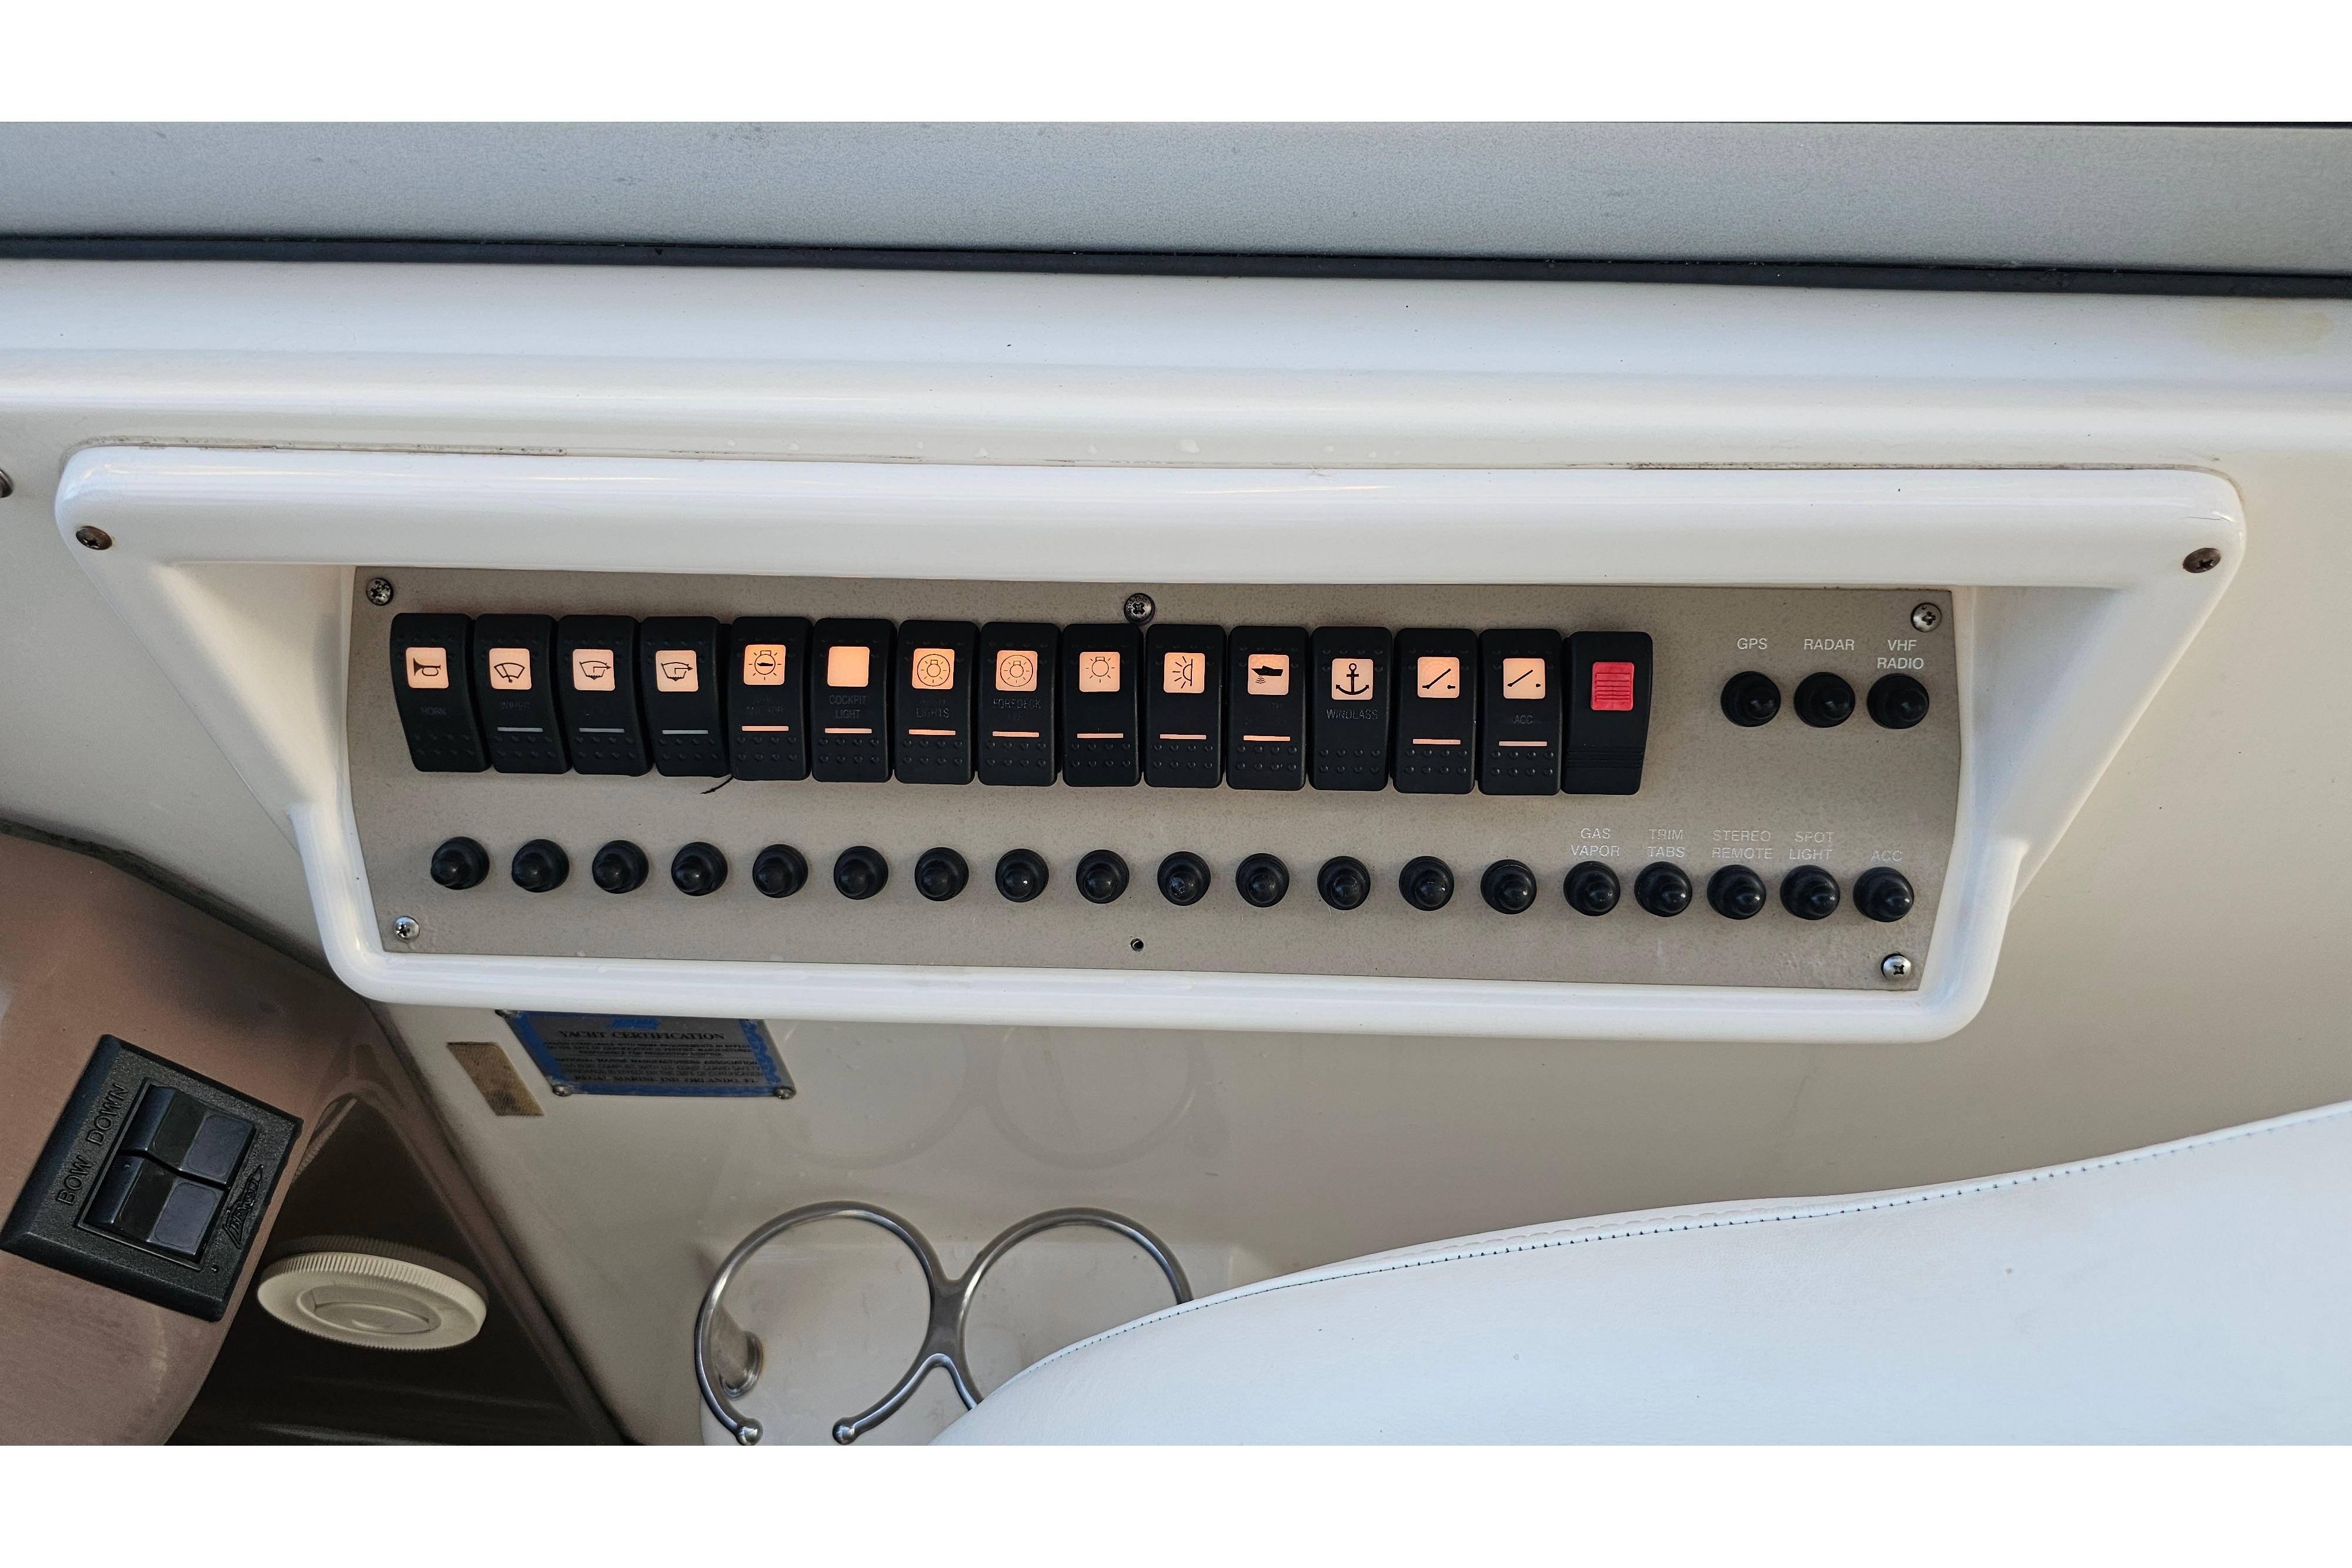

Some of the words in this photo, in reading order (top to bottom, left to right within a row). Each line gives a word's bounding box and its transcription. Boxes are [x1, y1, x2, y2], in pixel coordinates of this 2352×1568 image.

[1736, 637, 1768, 650] GPS
[1803, 638, 1855, 651] RADAR
[1887, 639, 1917, 651] VHF
[1876, 657, 1925, 670] RADIO
[828, 694, 867, 705] COCKPIT
[835, 708, 861, 719] LIGHT
[916, 707, 950, 718] LIGHTS
[1326, 708, 1379, 720] WINDLASS
[1514, 714, 1534, 724] ACC
[1580, 827, 1611, 840] GAS
[1648, 828, 1683, 841] TRIM
[1712, 830, 1771, 842] STEREO
[1794, 831, 1835, 843] SPOT
[1571, 845, 1620, 857] VAPOR
[1647, 845, 1685, 858] TABS
[1711, 847, 1773, 860] REMOTE
[1789, 848, 1833, 861] LIGHT
[1870, 849, 1902, 862] ACC
[558, 1030, 607, 1039] YACHT
[612, 1031, 726, 1040] CERTIFICATION
[56, 1154, 93, 1206] BOW
[85, 1084, 129, 1147] DOWN
